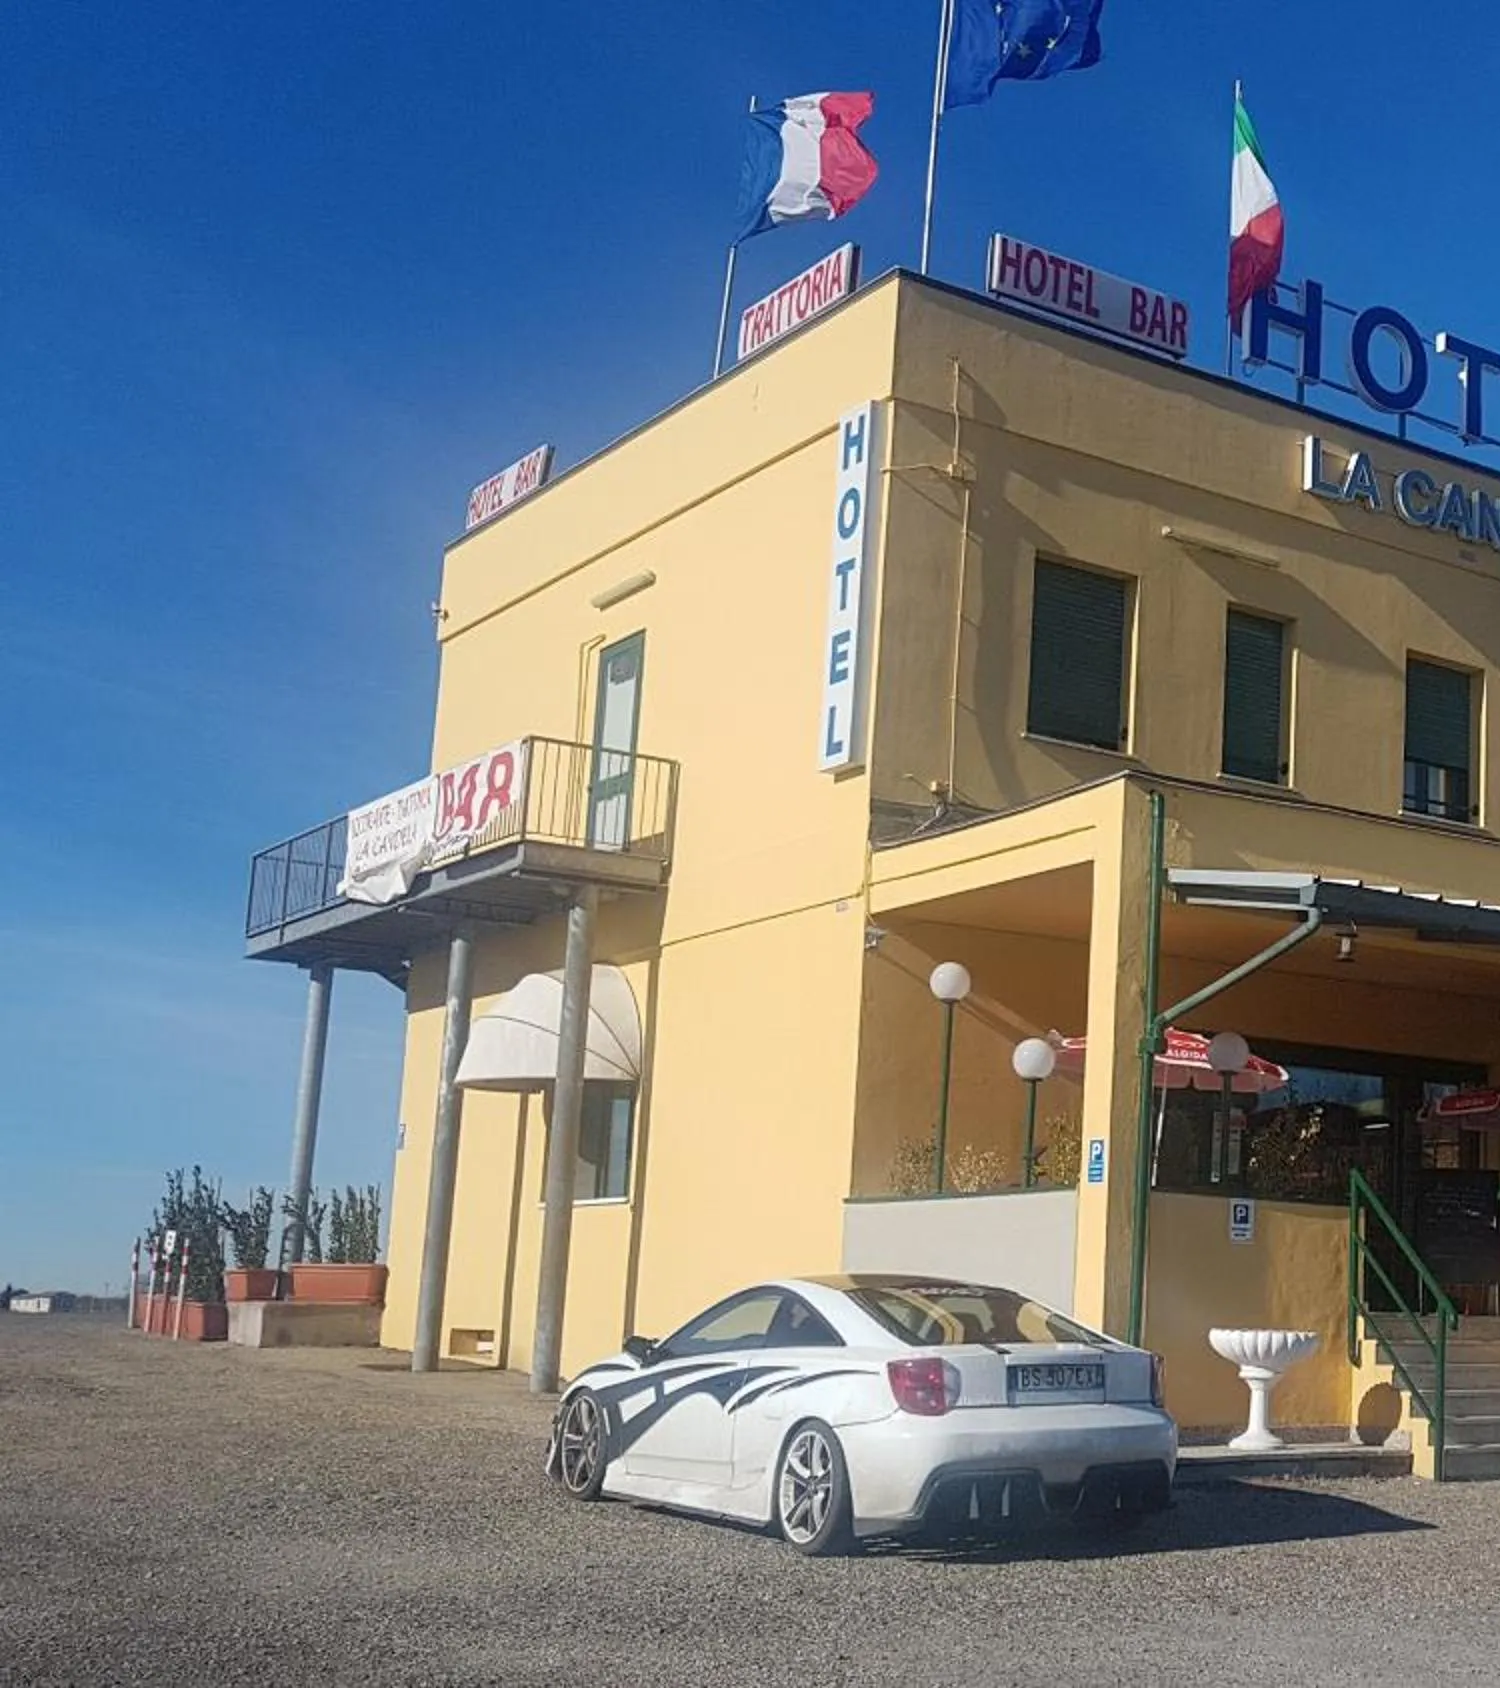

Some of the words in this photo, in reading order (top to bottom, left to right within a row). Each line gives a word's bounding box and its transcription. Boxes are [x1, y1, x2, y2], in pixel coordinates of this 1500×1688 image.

[743, 251, 843, 353] TRATTORIA
[1001, 238, 1099, 318] HOTEL
[1130, 287, 1187, 348] BAR
[1303, 435, 1382, 512] LA
[826, 413, 866, 758] HOTEL
